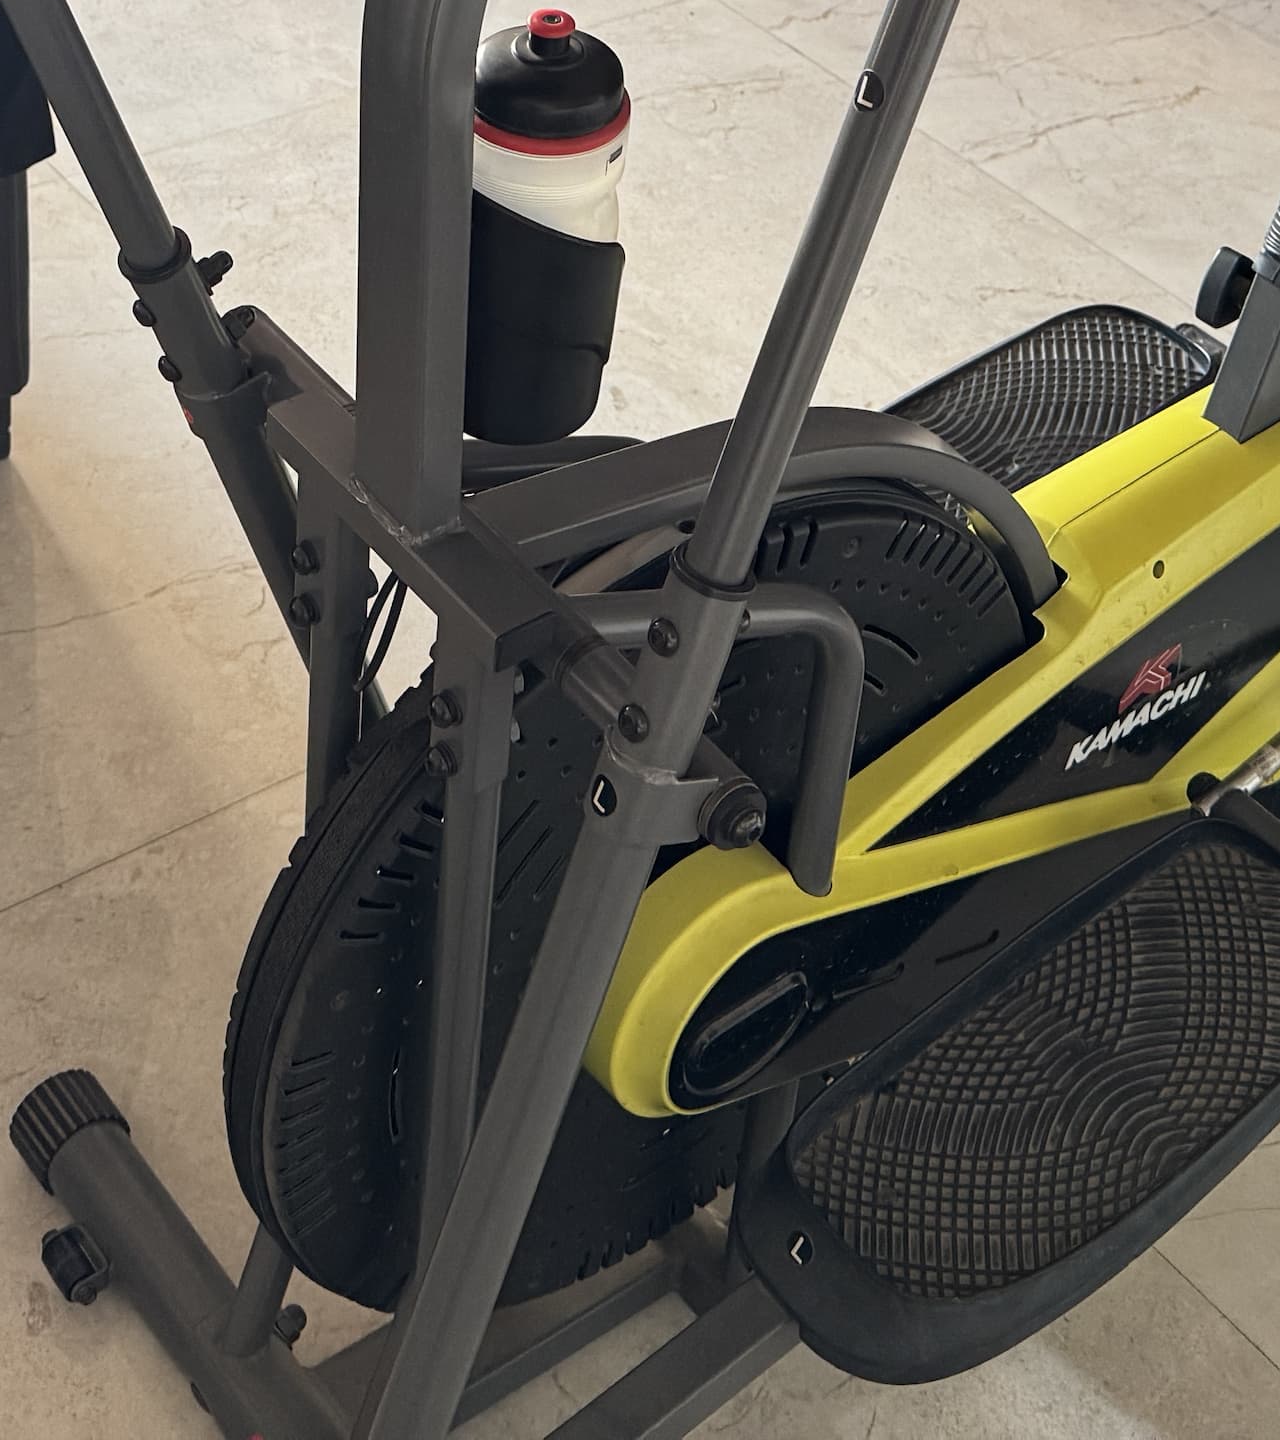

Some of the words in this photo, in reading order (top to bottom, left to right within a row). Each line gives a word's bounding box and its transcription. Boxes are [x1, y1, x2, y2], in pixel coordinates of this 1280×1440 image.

[857, 75, 874, 109] L
[1064, 670, 1208, 771] KAMACHI
[593, 779, 606, 813] L
[790, 1236, 805, 1265] L
